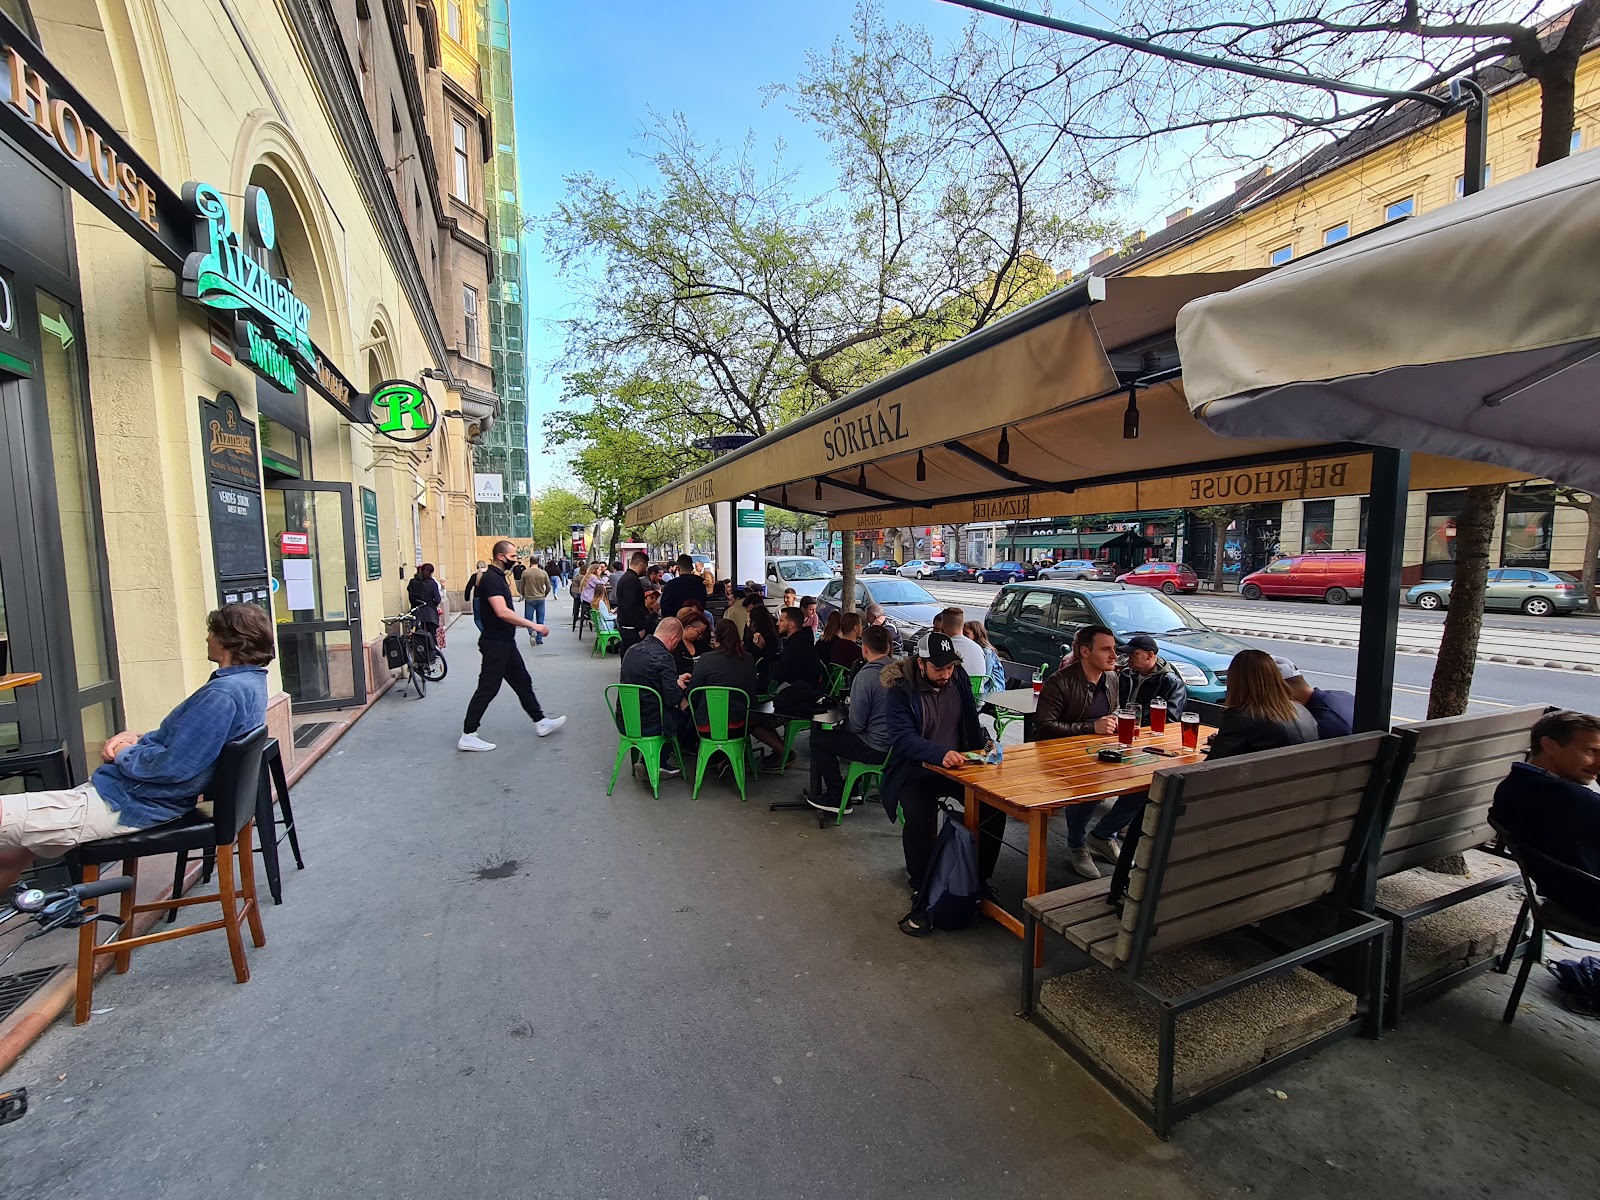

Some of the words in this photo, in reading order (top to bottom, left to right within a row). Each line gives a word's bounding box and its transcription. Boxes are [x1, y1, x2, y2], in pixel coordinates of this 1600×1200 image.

[3, 44, 161, 234] HOUSE
[195, 182, 313, 347] Rizmajer
[209, 420, 252, 453] Rizmajer
[373, 386, 431, 432] R
[823, 398, 910, 462] SÖRHÁZ
